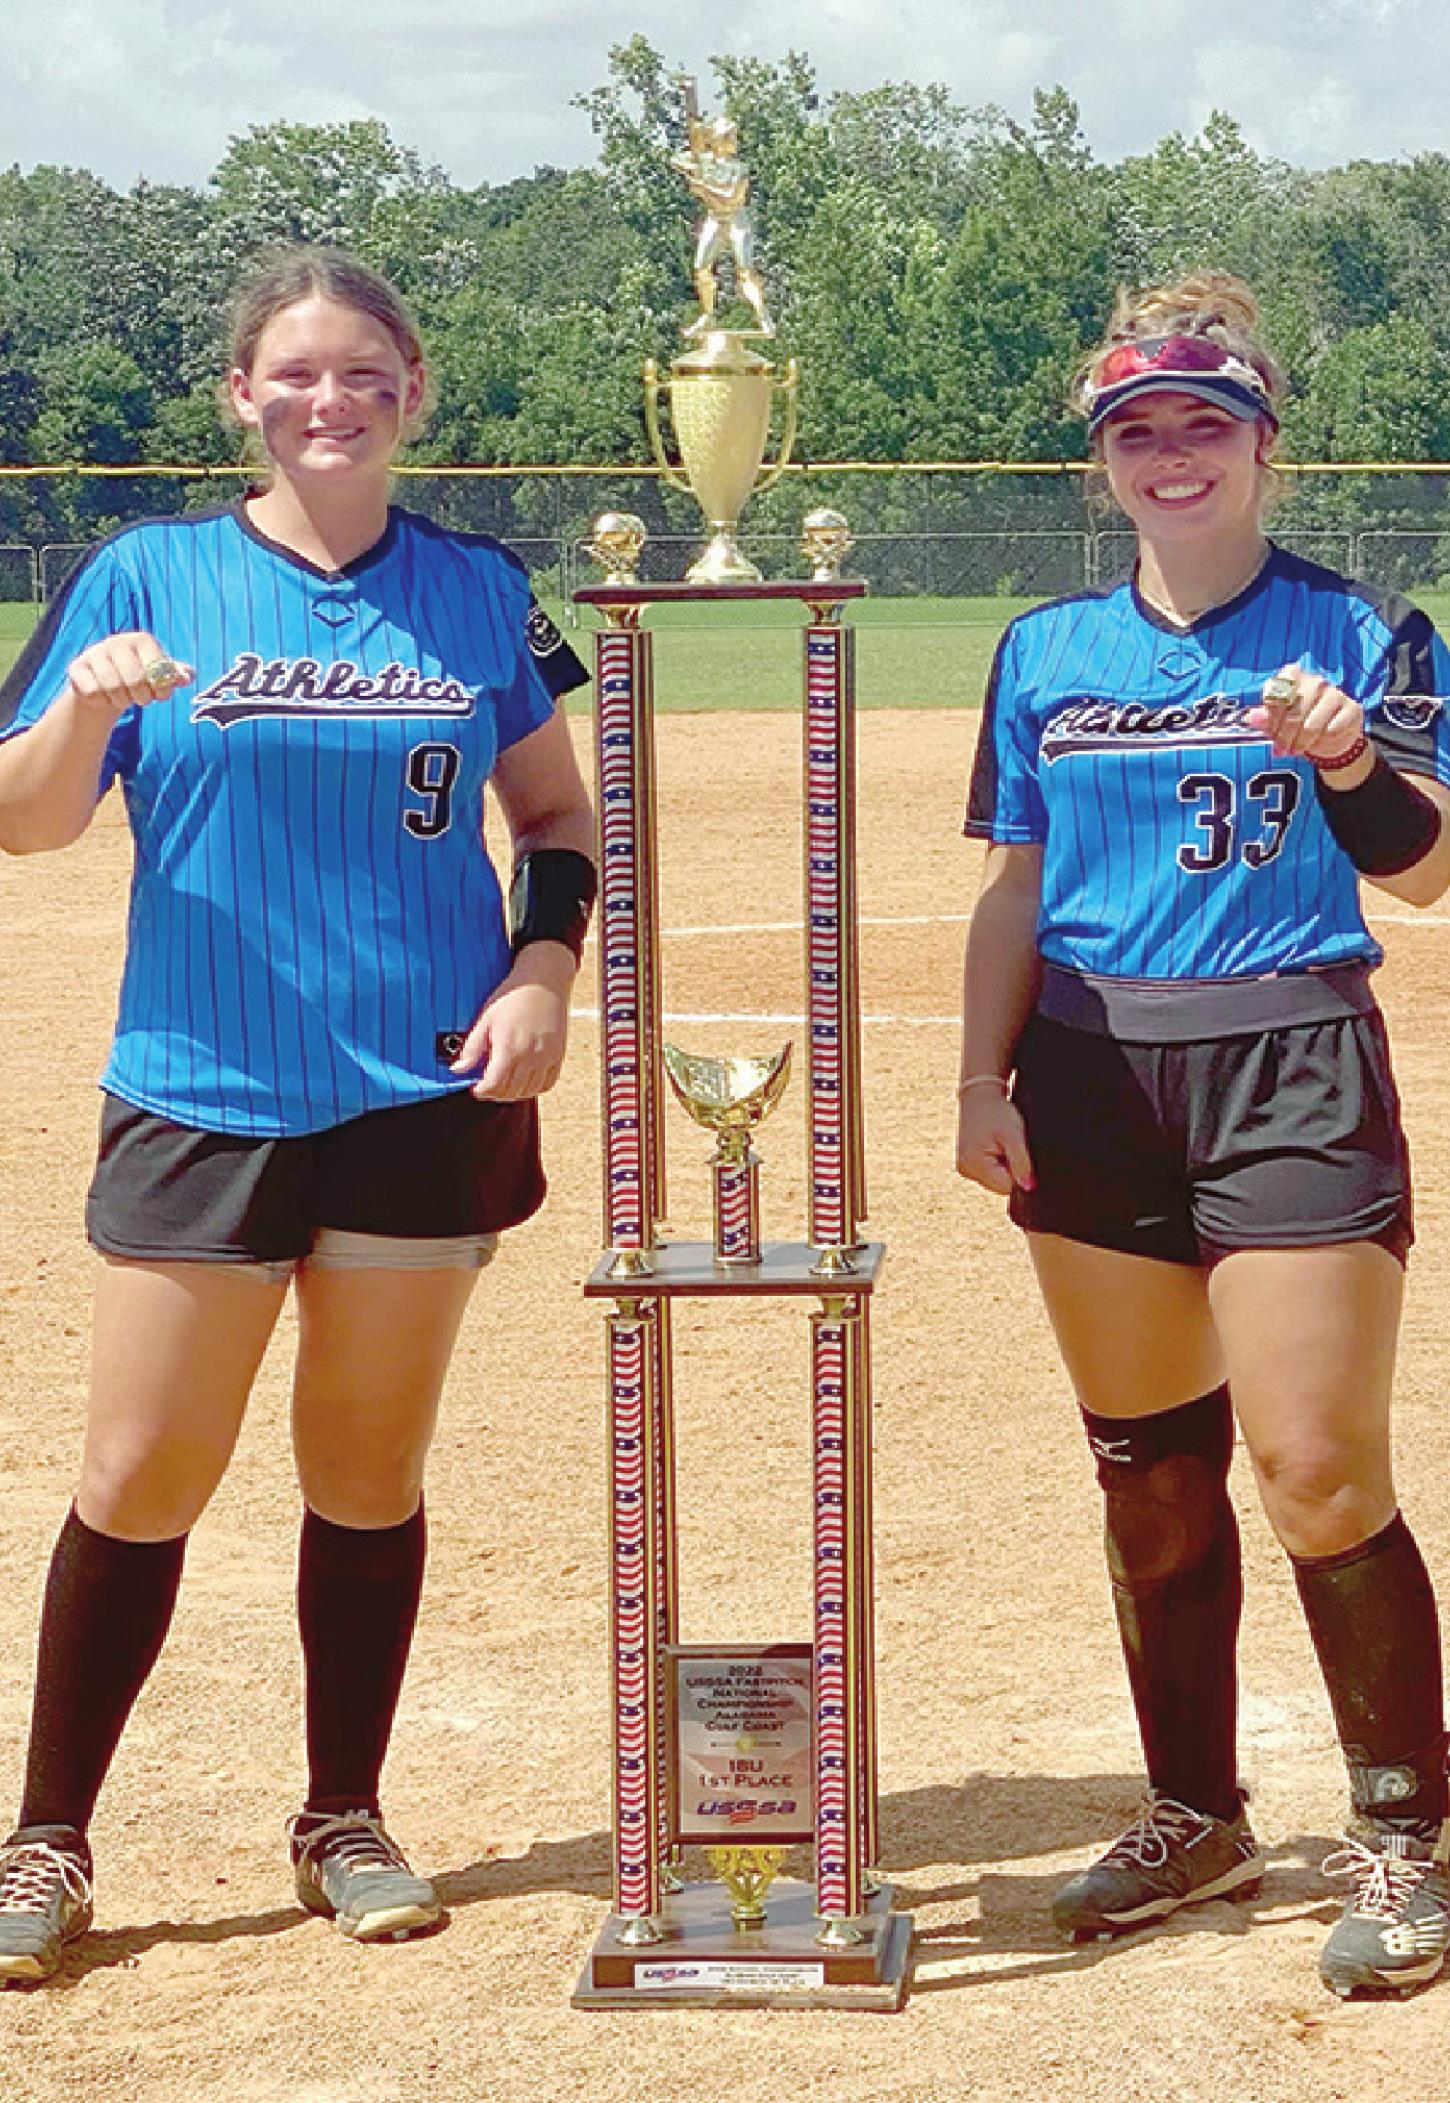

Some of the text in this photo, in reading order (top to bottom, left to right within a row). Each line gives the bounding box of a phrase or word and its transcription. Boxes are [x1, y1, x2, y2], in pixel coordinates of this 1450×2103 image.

[191, 651, 474, 705] Athletics
[403, 741, 461, 840] 9
[1176, 770, 1301, 873] 33
[699, 1774, 793, 1788] 1ST PLACE
[729, 1759, 763, 1772] 18U
